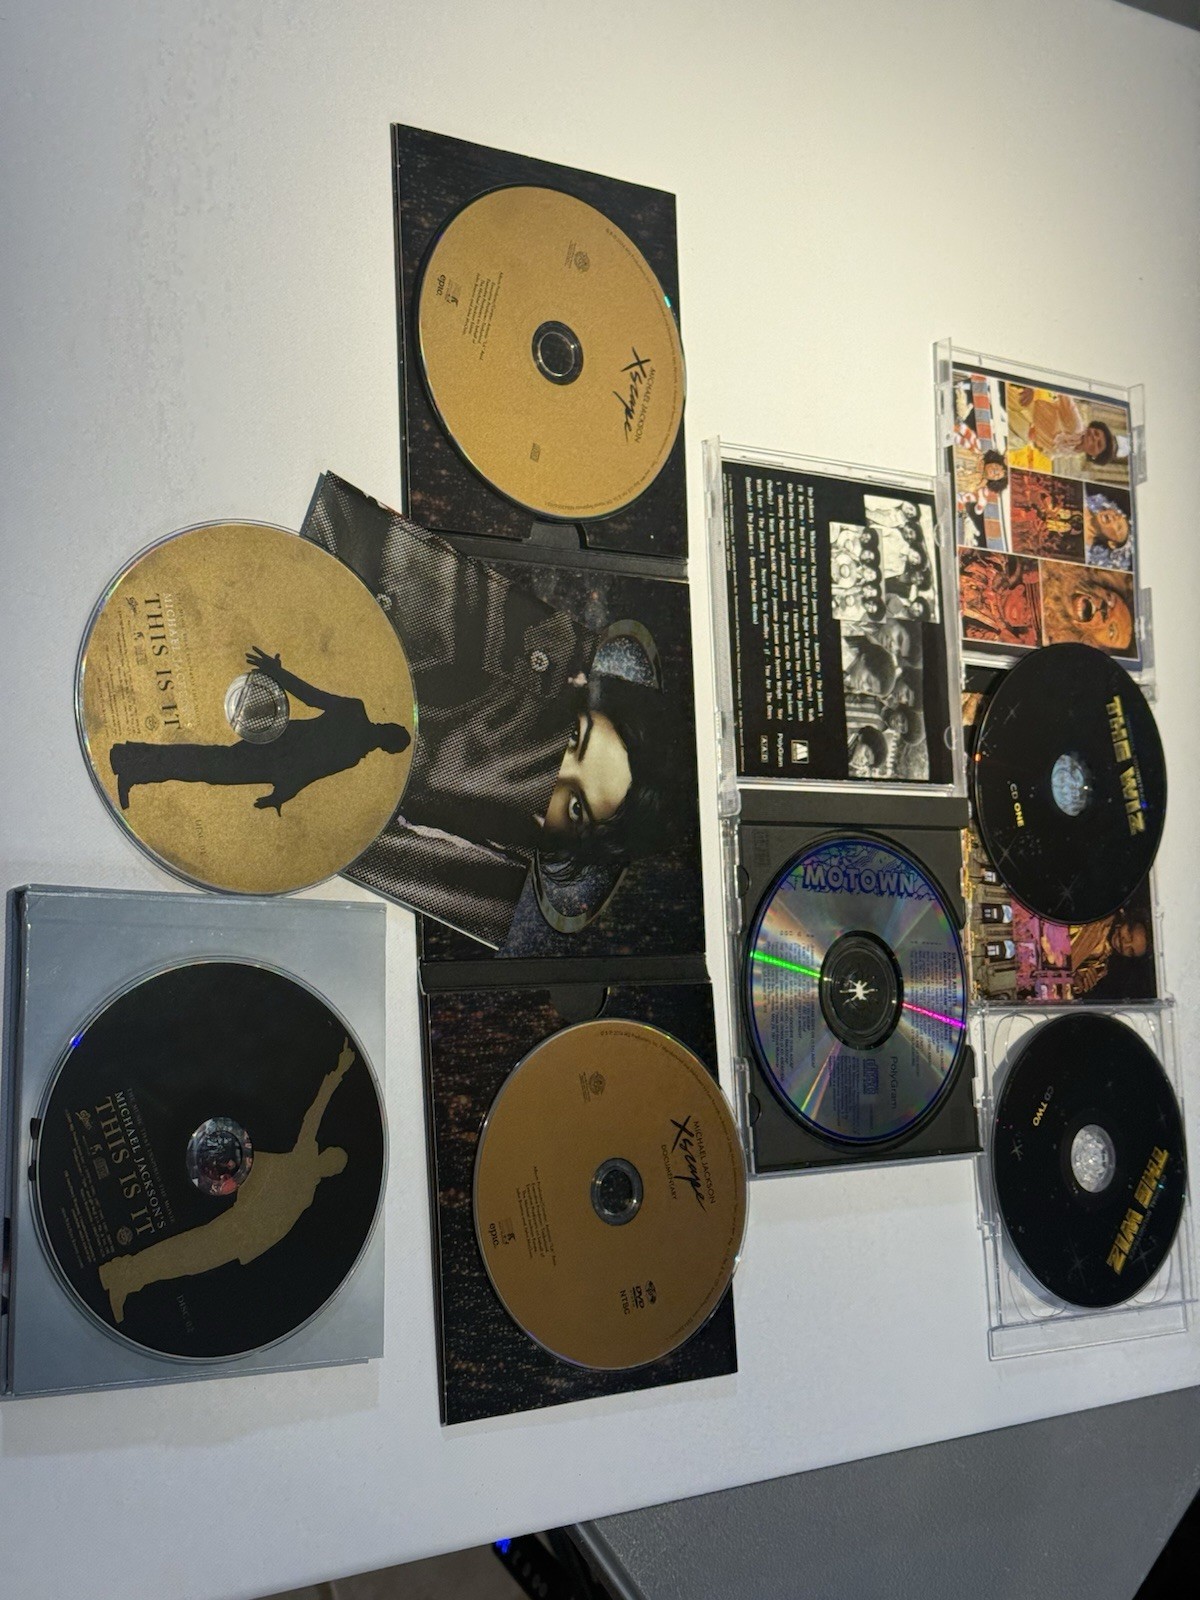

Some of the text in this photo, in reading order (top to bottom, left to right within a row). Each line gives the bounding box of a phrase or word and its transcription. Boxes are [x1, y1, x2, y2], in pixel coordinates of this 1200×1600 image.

[613, 347, 651, 442] Xscape
[634, 367, 656, 443] MICHAEL JACKSON
[807, 498, 815, 518] Jackson
[162, 592, 182, 652] MICHAEL
[772, 623, 780, 644] Jackson
[144, 593, 181, 731] THIS IS IT
[796, 700, 804, 721] Jackson
[1106, 695, 1132, 763] THE
[1119, 766, 1146, 836] WIZ
[1010, 783, 1024, 827] CD ONE
[803, 864, 915, 895] MOTOWN
[889, 1056, 899, 1110] PolyGram
[1032, 1086, 1054, 1126] CD TWO
[94, 1096, 130, 1164] THIS
[118, 1171, 142, 1199] IS
[130, 1206, 155, 1235] IT
[114, 1091, 167, 1229] MICHAEL JACKSON'S
[661, 1144, 677, 1200] DOCUMENTARY
[670, 1115, 707, 1213] Xscape
[693, 1121, 717, 1204] MICHAEL JACKSON
[1134, 1146, 1169, 1208] THE
[1106, 1208, 1144, 1275] WIZ
[620, 1290, 630, 1315] NTSC
